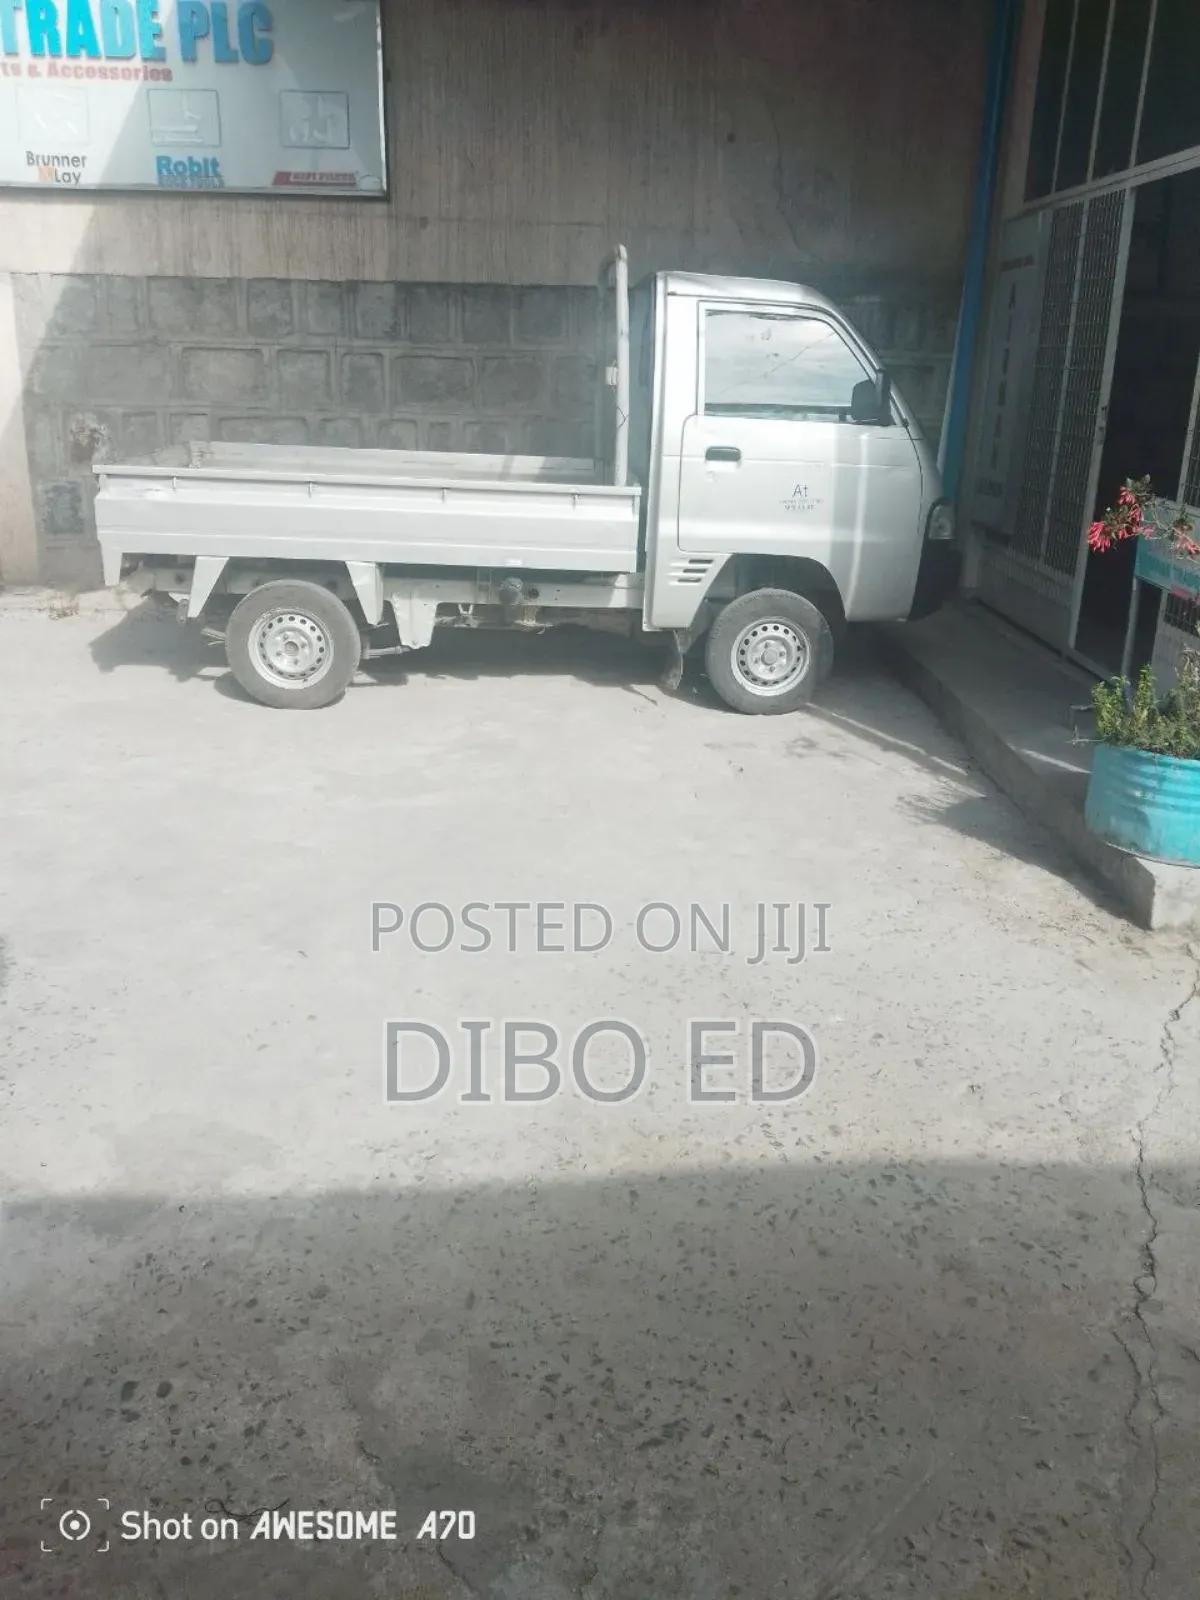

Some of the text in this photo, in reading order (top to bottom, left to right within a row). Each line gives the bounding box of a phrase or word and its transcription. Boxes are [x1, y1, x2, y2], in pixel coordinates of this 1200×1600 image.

[0, 0, 276, 65] TRADE PLC
[47, 61, 173, 82] Accessories
[26, 150, 87, 168] Brunner
[54, 168, 82, 186] Lay
